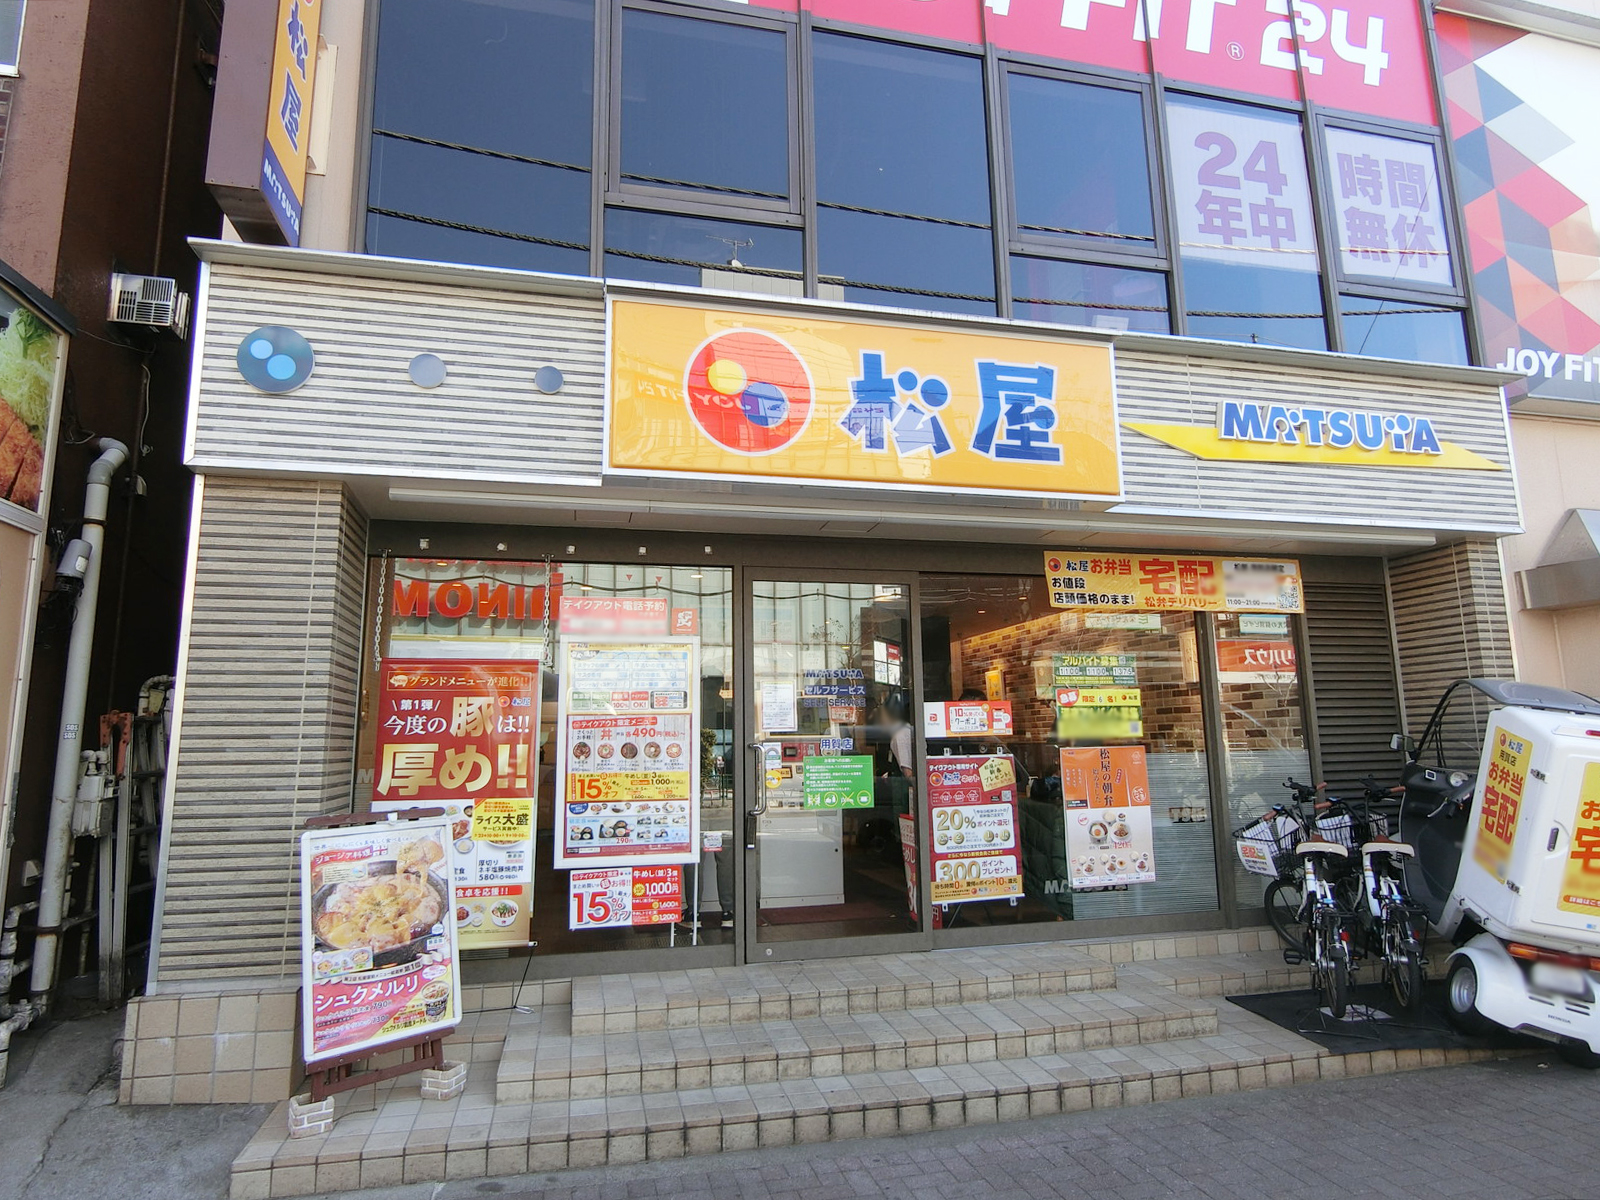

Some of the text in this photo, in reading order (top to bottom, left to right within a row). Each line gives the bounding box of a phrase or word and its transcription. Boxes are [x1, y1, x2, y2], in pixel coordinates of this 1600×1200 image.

[1259, 0, 1390, 87] 24
[1194, 131, 1289, 196] 24
[1337, 153, 1434, 212] 時間
[1194, 189, 1300, 250] 年中
[1343, 206, 1438, 268] 無休
[1496, 347, 1561, 378] JOY
[837, 350, 1065, 466] 松屋
[1217, 400, 1444, 457] MATSUYA
[1051, 577, 1085, 589] お値段
[1066, 560, 1090, 572] 松屋
[1090, 558, 1132, 576] お弁当
[1139, 558, 1217, 596] 宅配
[1053, 592, 1135, 605] 店頭価格のまま!
[1144, 596, 1217, 608] 松弁デリバリー
[805, 686, 866, 696] セルフサービス
[821, 739, 854, 750] 用賀店
[377, 744, 529, 796] 厚め!!
[577, 779, 602, 799] 15
[1100, 747, 1114, 807] 松屋の朝弁
[1488, 761, 1523, 796] お弁当
[476, 813, 529, 826] ライス大盛
[936, 808, 977, 832] 20%
[1480, 785, 1519, 846] 宅配
[573, 891, 611, 923] 15
[314, 974, 418, 1012] シュクメルリ
